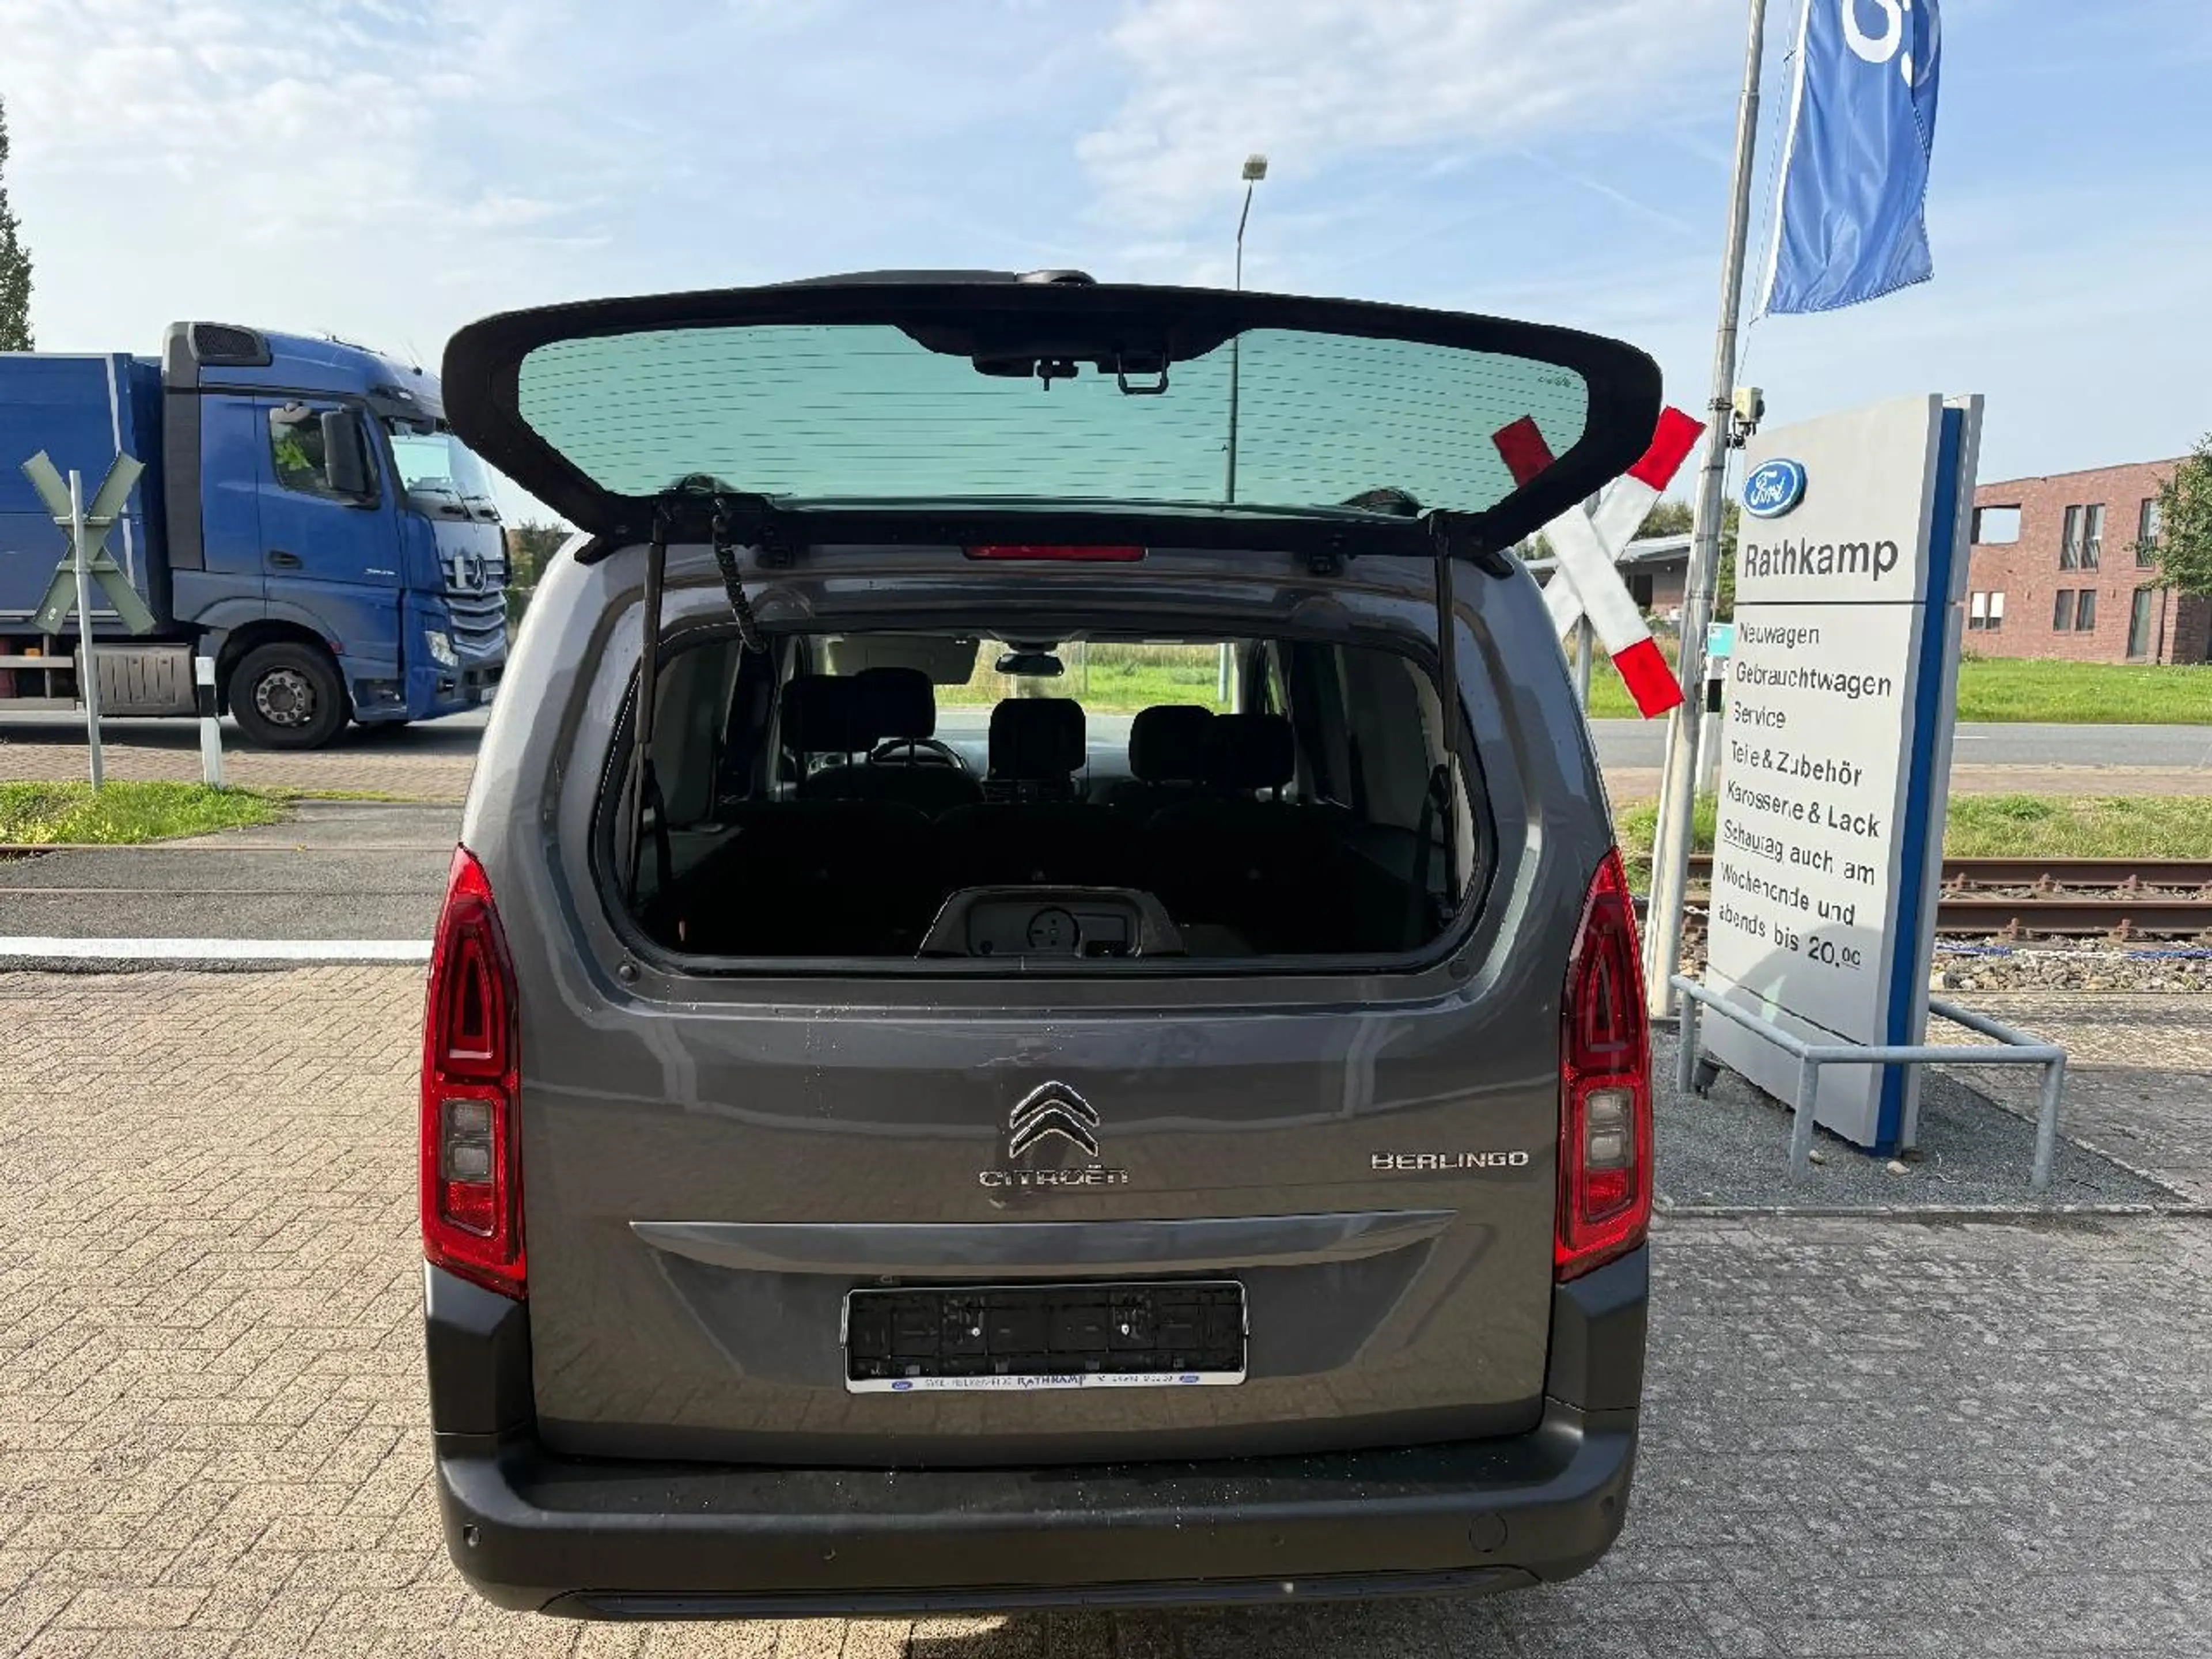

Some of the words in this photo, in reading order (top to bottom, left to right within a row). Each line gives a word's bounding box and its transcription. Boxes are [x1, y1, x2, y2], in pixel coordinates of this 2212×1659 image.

[1745, 537, 1899, 581] Rathkamp
[1739, 622, 1820, 649] Neuwagen
[1736, 662, 1891, 699] Gebrauchtwagen
[1734, 701, 1786, 729] Service
[1732, 740, 1760, 767] Teie
[1726, 781, 1804, 821] Karosserie
[1808, 801, 1821, 824] &
[1828, 804, 1881, 838] Lack
[1790, 845, 1833, 874] auch
[1843, 862, 1876, 886] am
[1721, 861, 1809, 911] Wochenende
[1818, 900, 1855, 927] und
[1719, 903, 1766, 938] abends
[1774, 922, 1800, 952] bis
[979, 1164, 1128, 1187] CITROËN
[1372, 1152, 1529, 1169] BERLINGO
